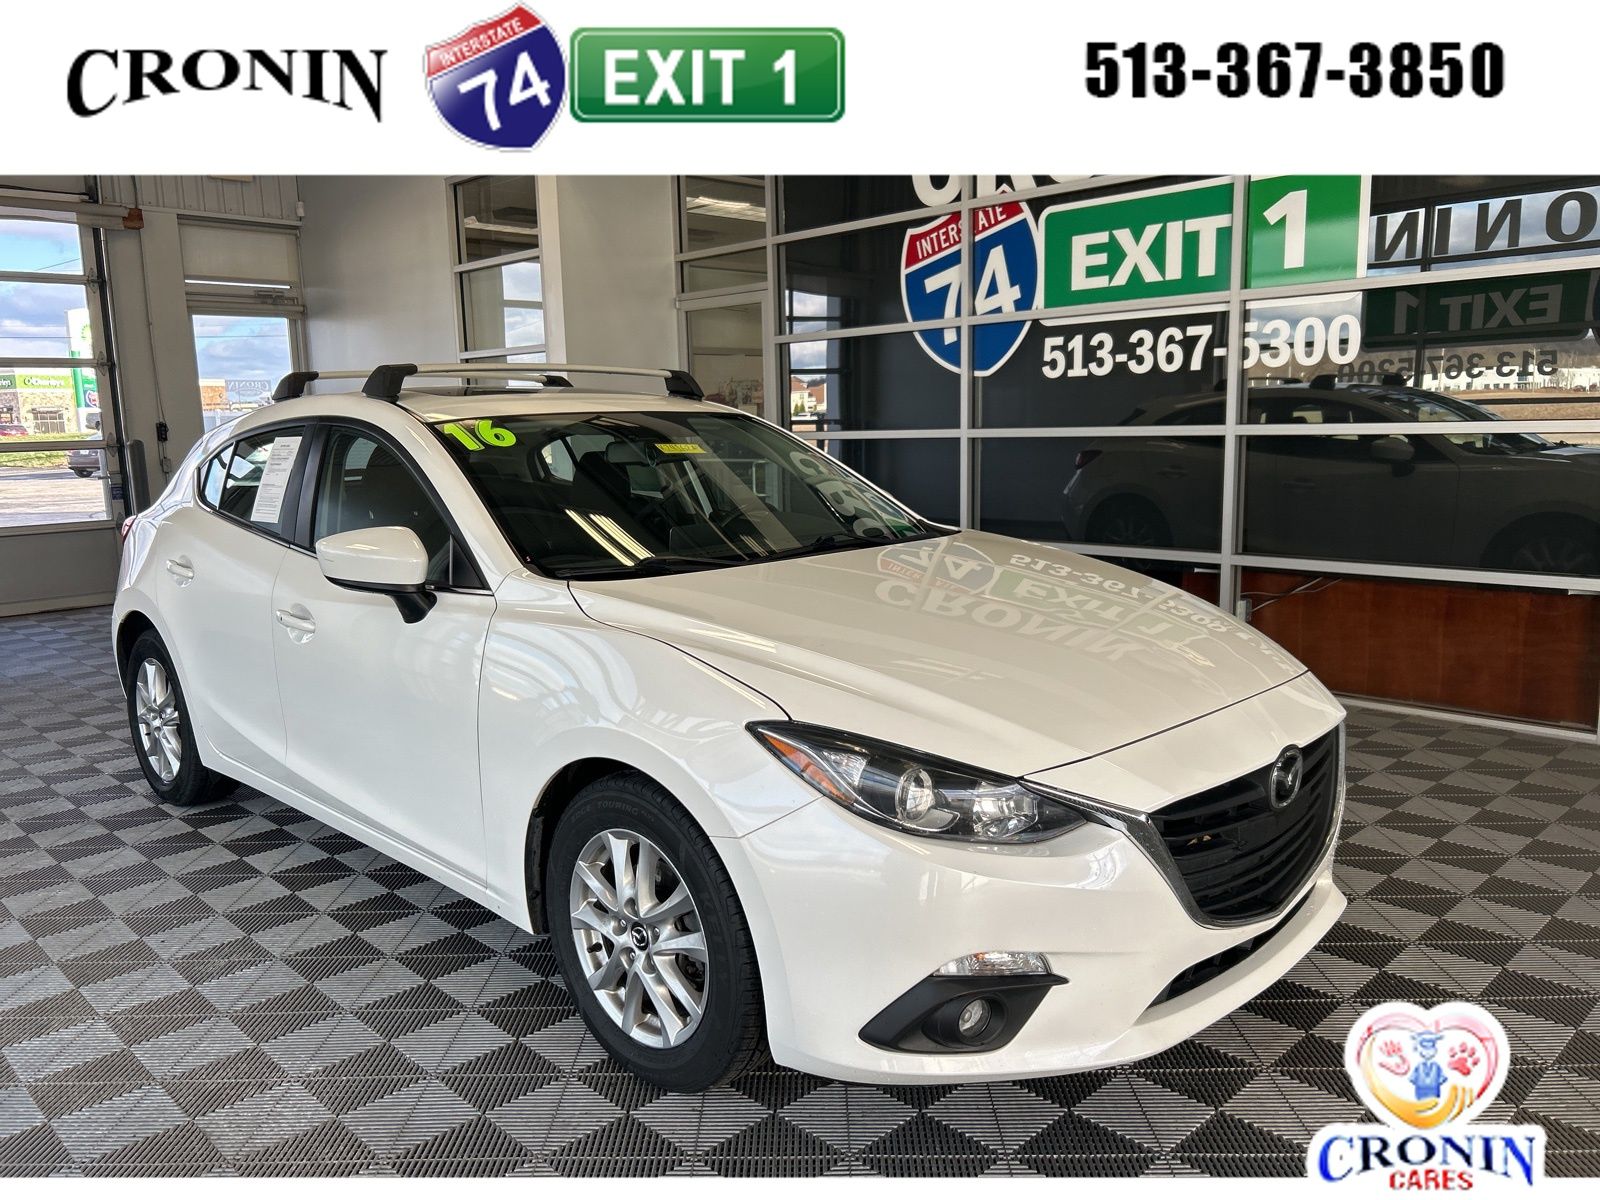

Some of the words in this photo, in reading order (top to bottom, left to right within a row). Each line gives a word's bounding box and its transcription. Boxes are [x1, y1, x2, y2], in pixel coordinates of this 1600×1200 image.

[915, 205, 1007, 260] INTERATE
[1070, 213, 1233, 292] EXIT
[1262, 189, 1308, 270] 1
[923, 243, 1022, 346] 74
[1041, 314, 1362, 379] 513-367-5300
[443, 419, 517, 451] 16
